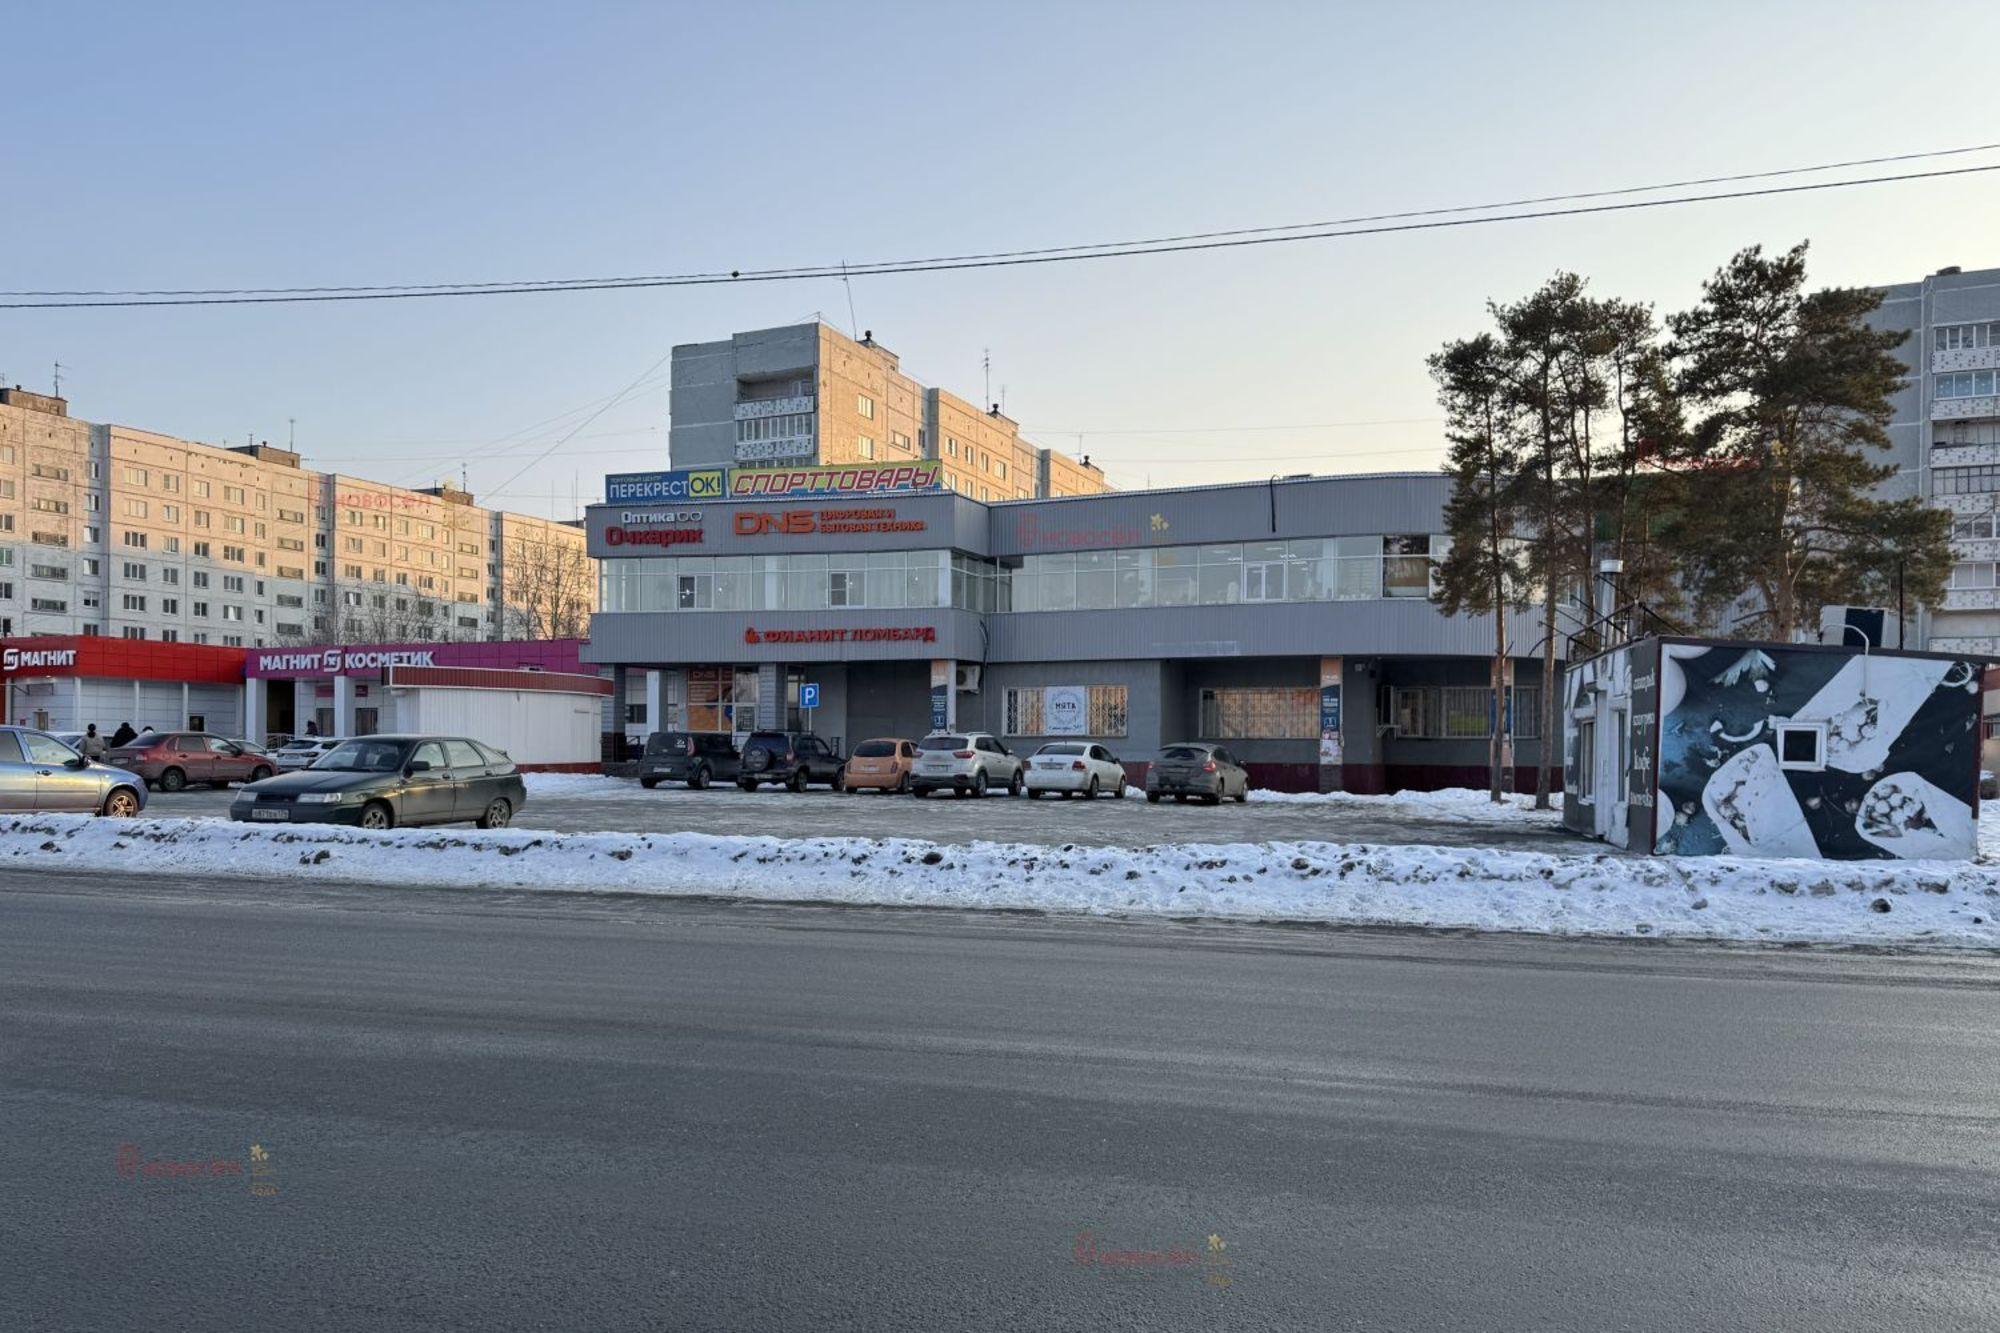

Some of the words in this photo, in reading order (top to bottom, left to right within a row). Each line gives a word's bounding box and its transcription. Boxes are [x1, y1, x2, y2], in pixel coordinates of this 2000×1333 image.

[732, 466, 938, 496] СПОРТТОВАРЫ
[621, 511, 675, 524] Оптика
[734, 509, 815, 536] DNS
[605, 526, 704, 548] Очкарик
[763, 629, 847, 643] ФИАНИТ
[851, 627, 936, 643] ЛОМБАРД
[20, 650, 76, 667] МАГНИТ
[259, 654, 322, 671] МАГНИТ
[344, 651, 435, 669] КОСМЕТИК
[805, 688, 816, 704] P
